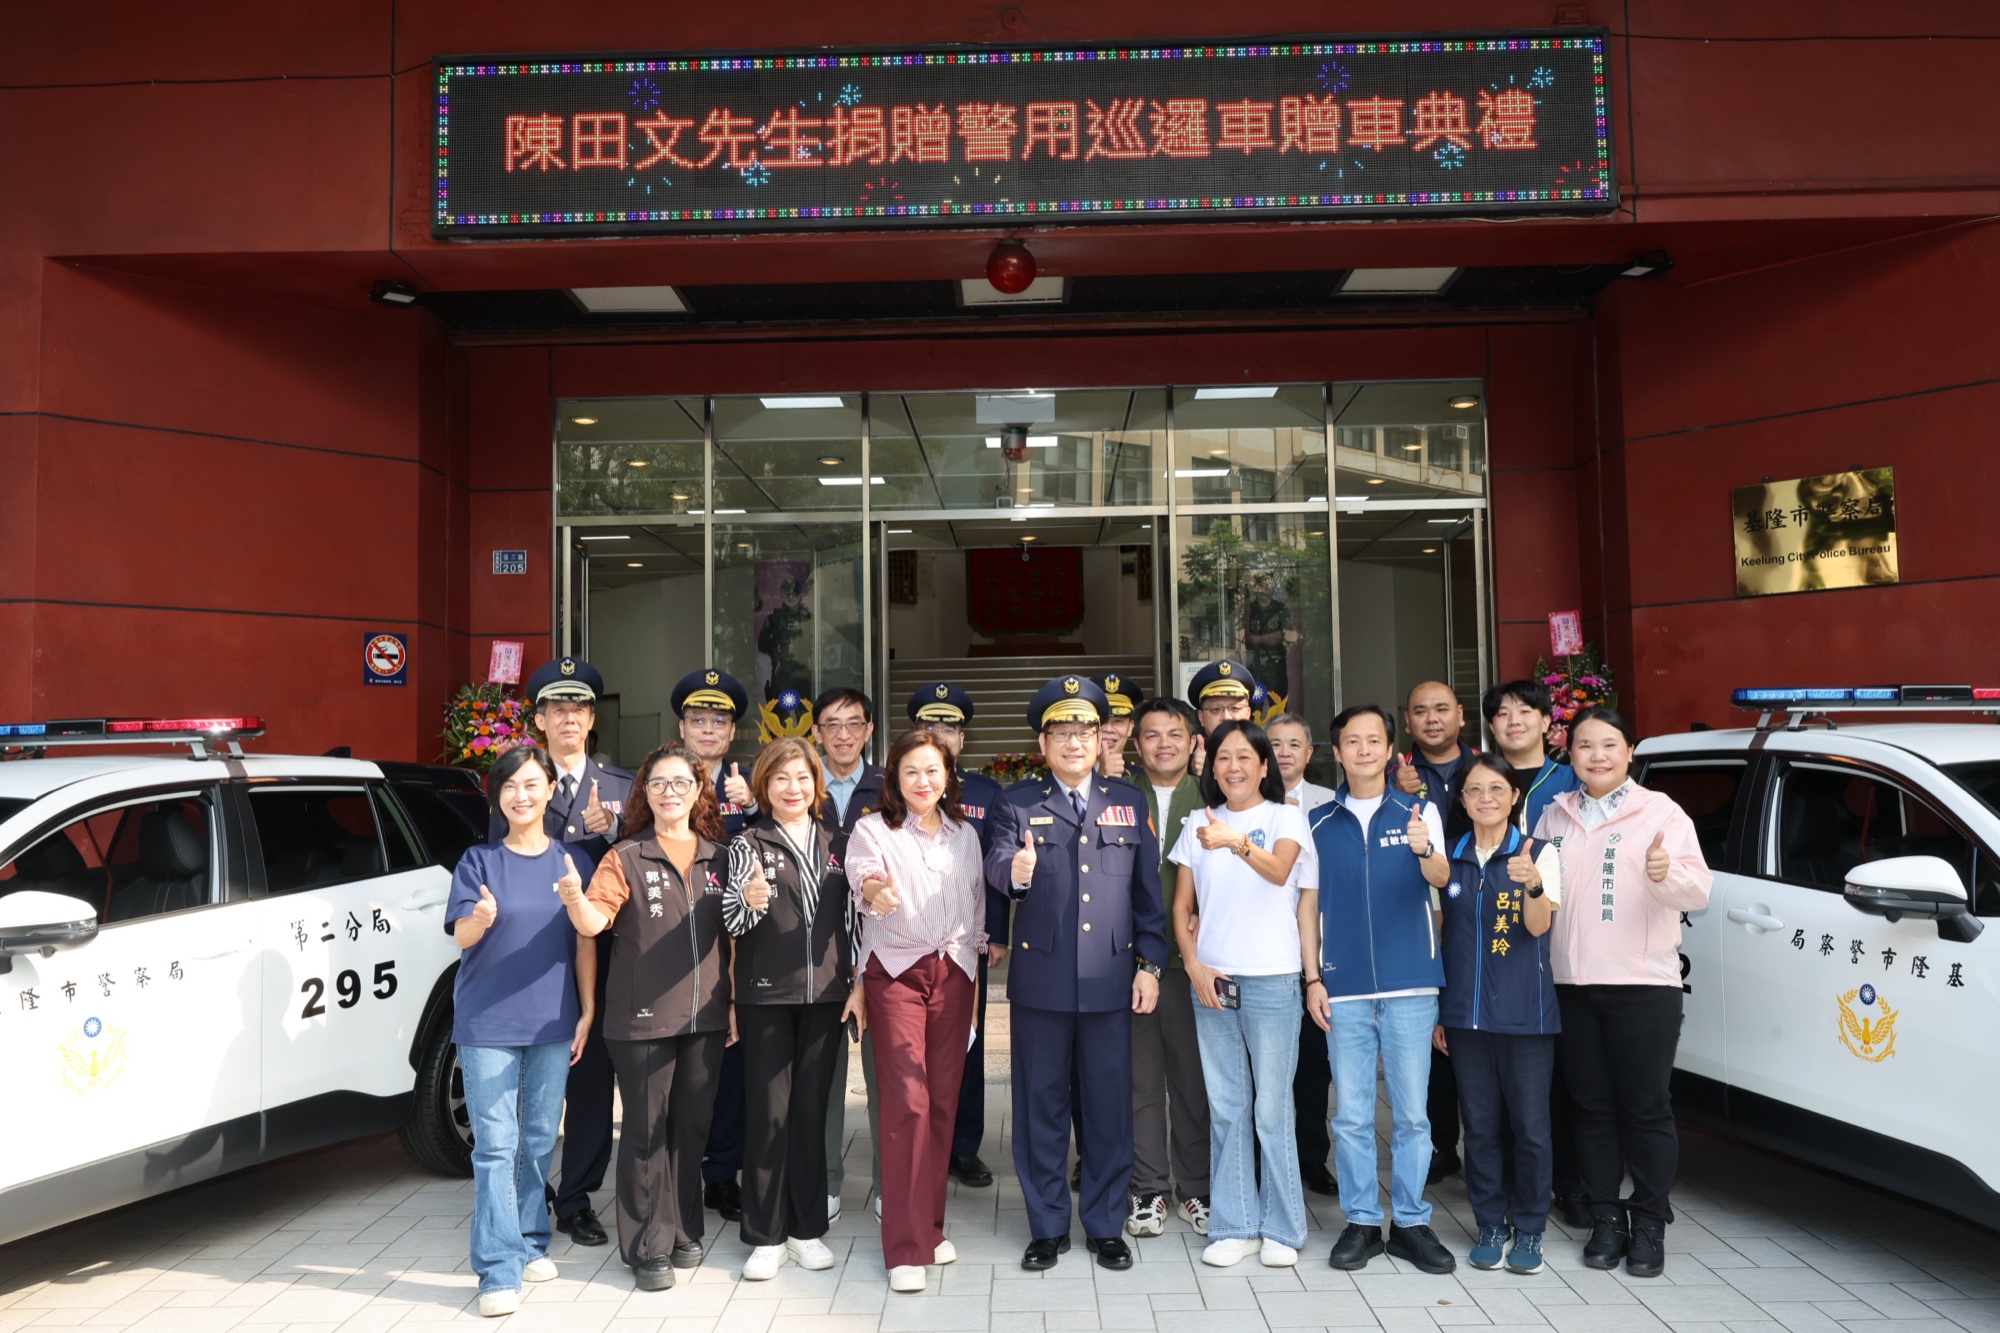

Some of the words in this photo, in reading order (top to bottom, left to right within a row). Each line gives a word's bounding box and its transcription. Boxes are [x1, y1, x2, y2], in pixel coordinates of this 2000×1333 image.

[505, 89, 1538, 172] 陳田文先生捐贈警用巡邏車贈車典禮
[1742, 498, 1884, 533] 基隆市警察局
[503, 563, 524, 573] 205
[1741, 554, 1785, 566] Keelung
[1787, 551, 1808, 563] City
[1811, 548, 1846, 560] Police
[1849, 544, 1891, 556] Bureau
[645, 871, 664, 918] 郭美秀
[1511, 888, 1522, 924] 市議員
[1601, 847, 1616, 922] 基隆市議員
[290, 907, 392, 951] 第二分局
[1491, 892, 1511, 957] 呂美玲
[301, 960, 398, 1019] 295
